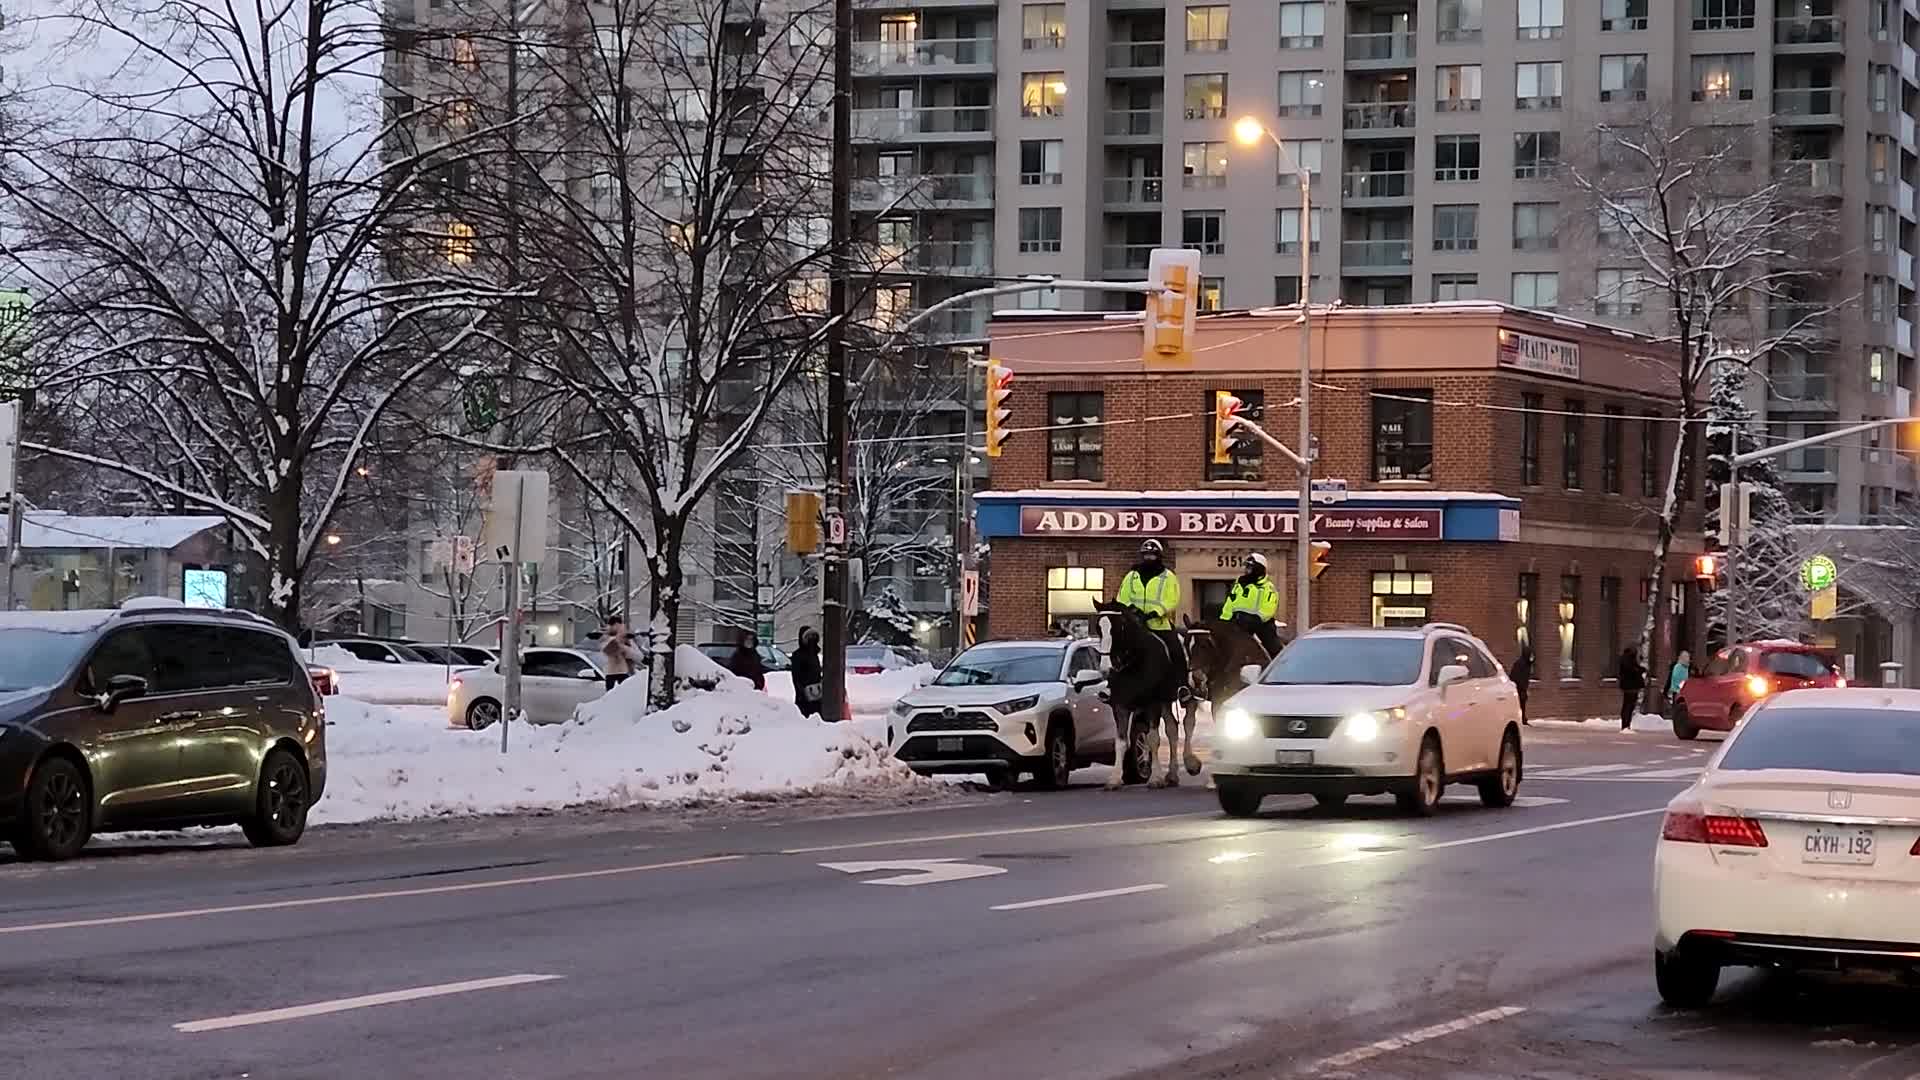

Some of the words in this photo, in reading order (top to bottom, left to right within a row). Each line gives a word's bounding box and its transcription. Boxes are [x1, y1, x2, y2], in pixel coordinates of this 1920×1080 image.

[1381, 424, 1403, 432] NAIL
[1379, 466, 1401, 474] HAIR
[1035, 511, 1168, 532] ADDED
[1179, 512, 1323, 534] BEAUTY
[1326, 517, 1354, 532] Beauty
[1356, 516, 1391, 532] Supplies
[1393, 517, 1402, 529] &
[1404, 516, 1429, 529] Salon
[1217, 555, 1243, 568] 5151
